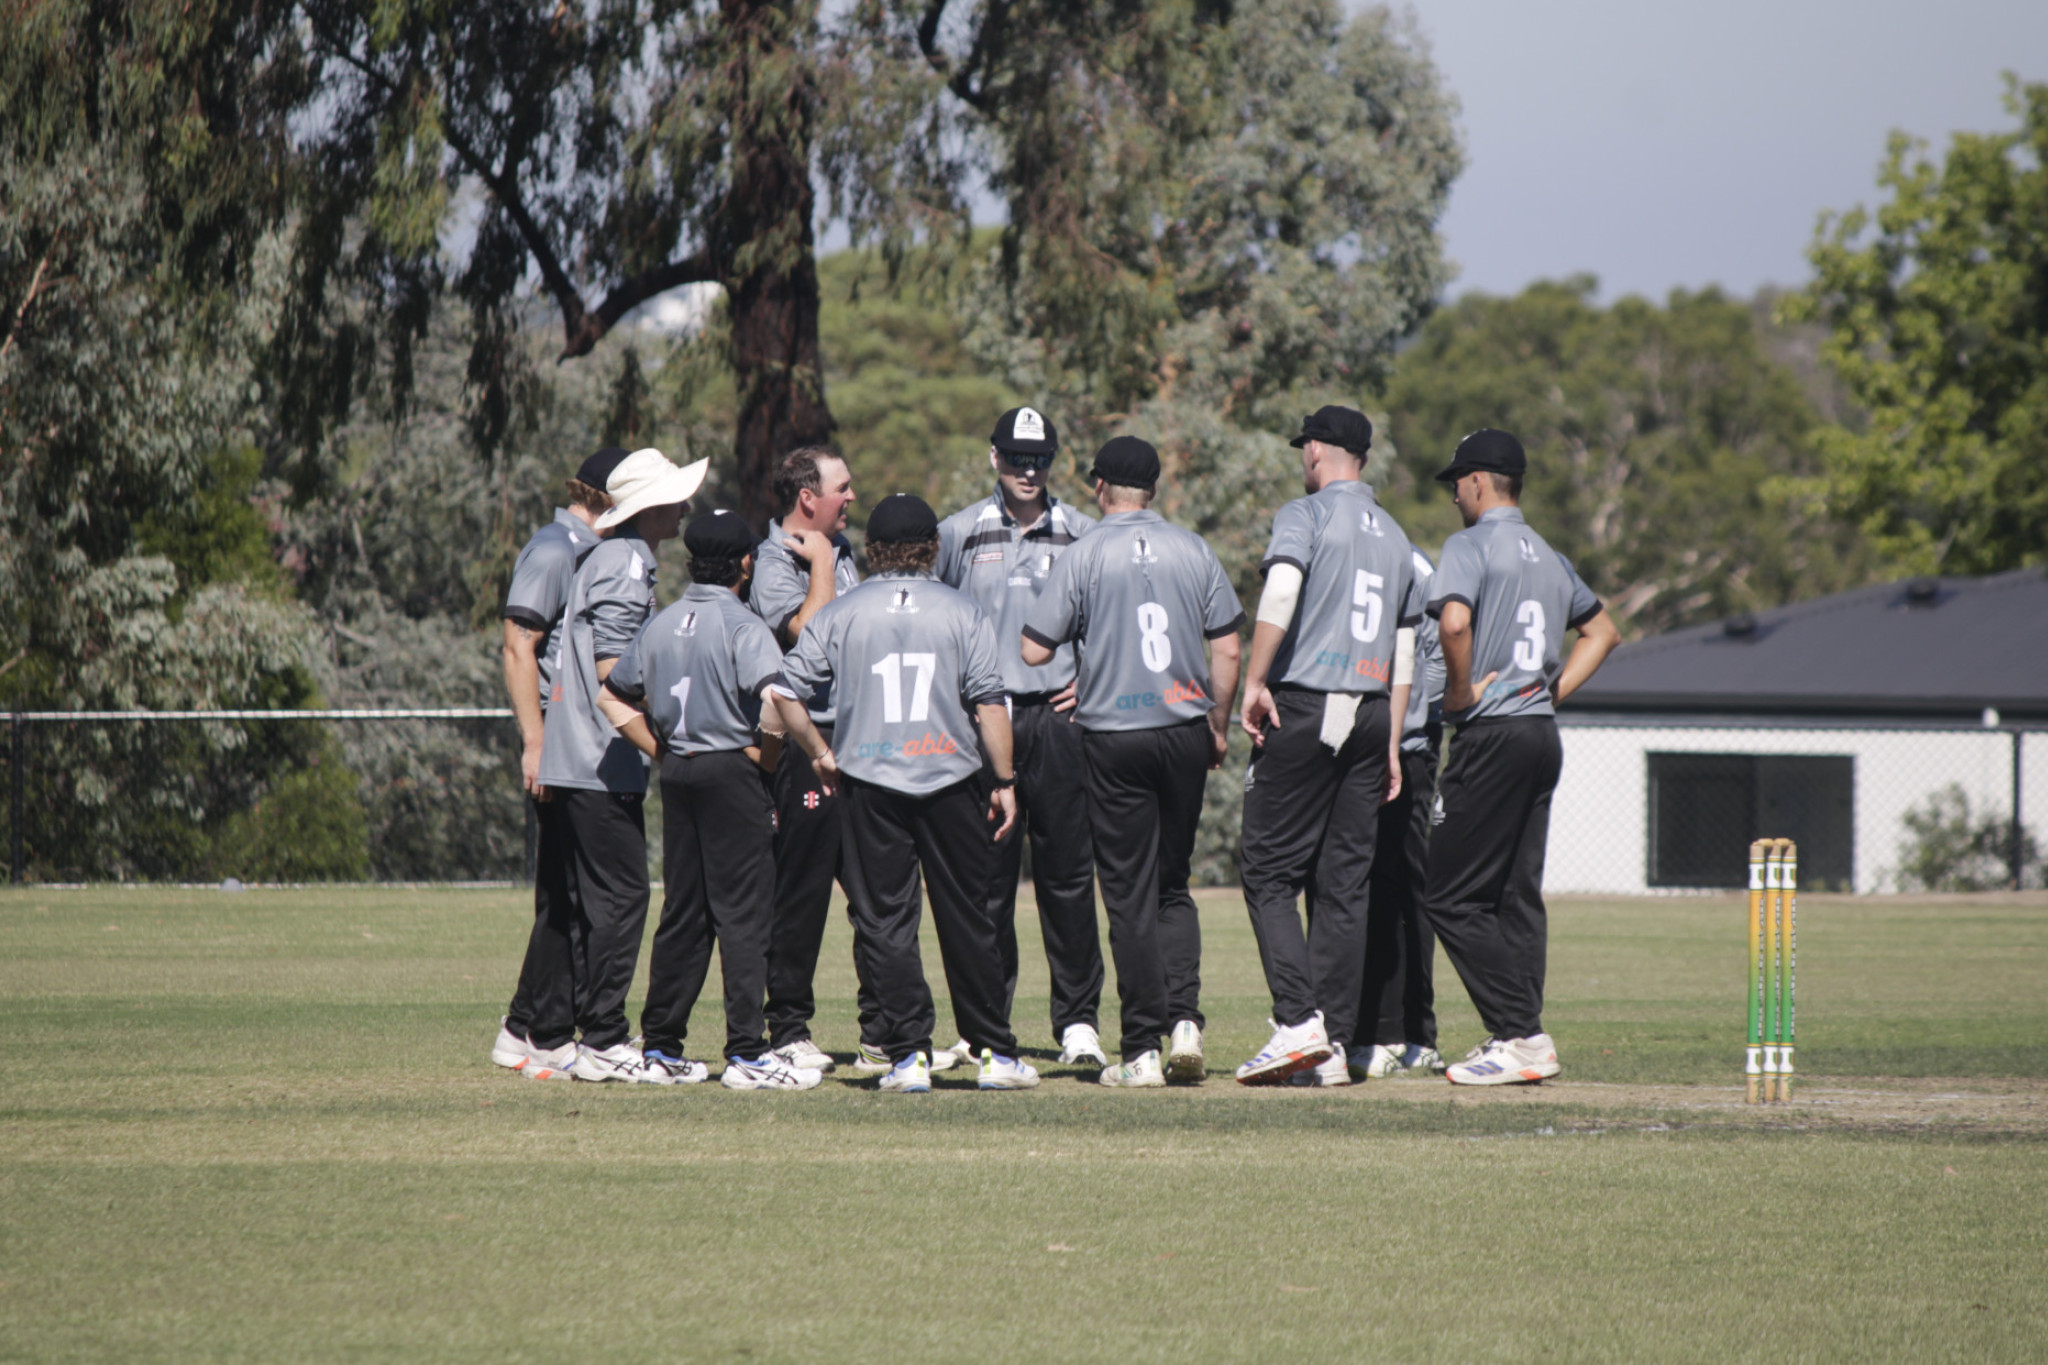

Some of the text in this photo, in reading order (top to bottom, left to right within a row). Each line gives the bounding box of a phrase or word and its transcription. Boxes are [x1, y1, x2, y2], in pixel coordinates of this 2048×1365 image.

[1137, 602, 1172, 674] 8
[1350, 568, 1384, 643] 5
[1513, 599, 1546, 672] 3
[871, 652, 937, 724] 17
[1316, 650, 1391, 683] are-abl
[670, 676, 692, 740] 1
[857, 732, 958, 758] are-able
